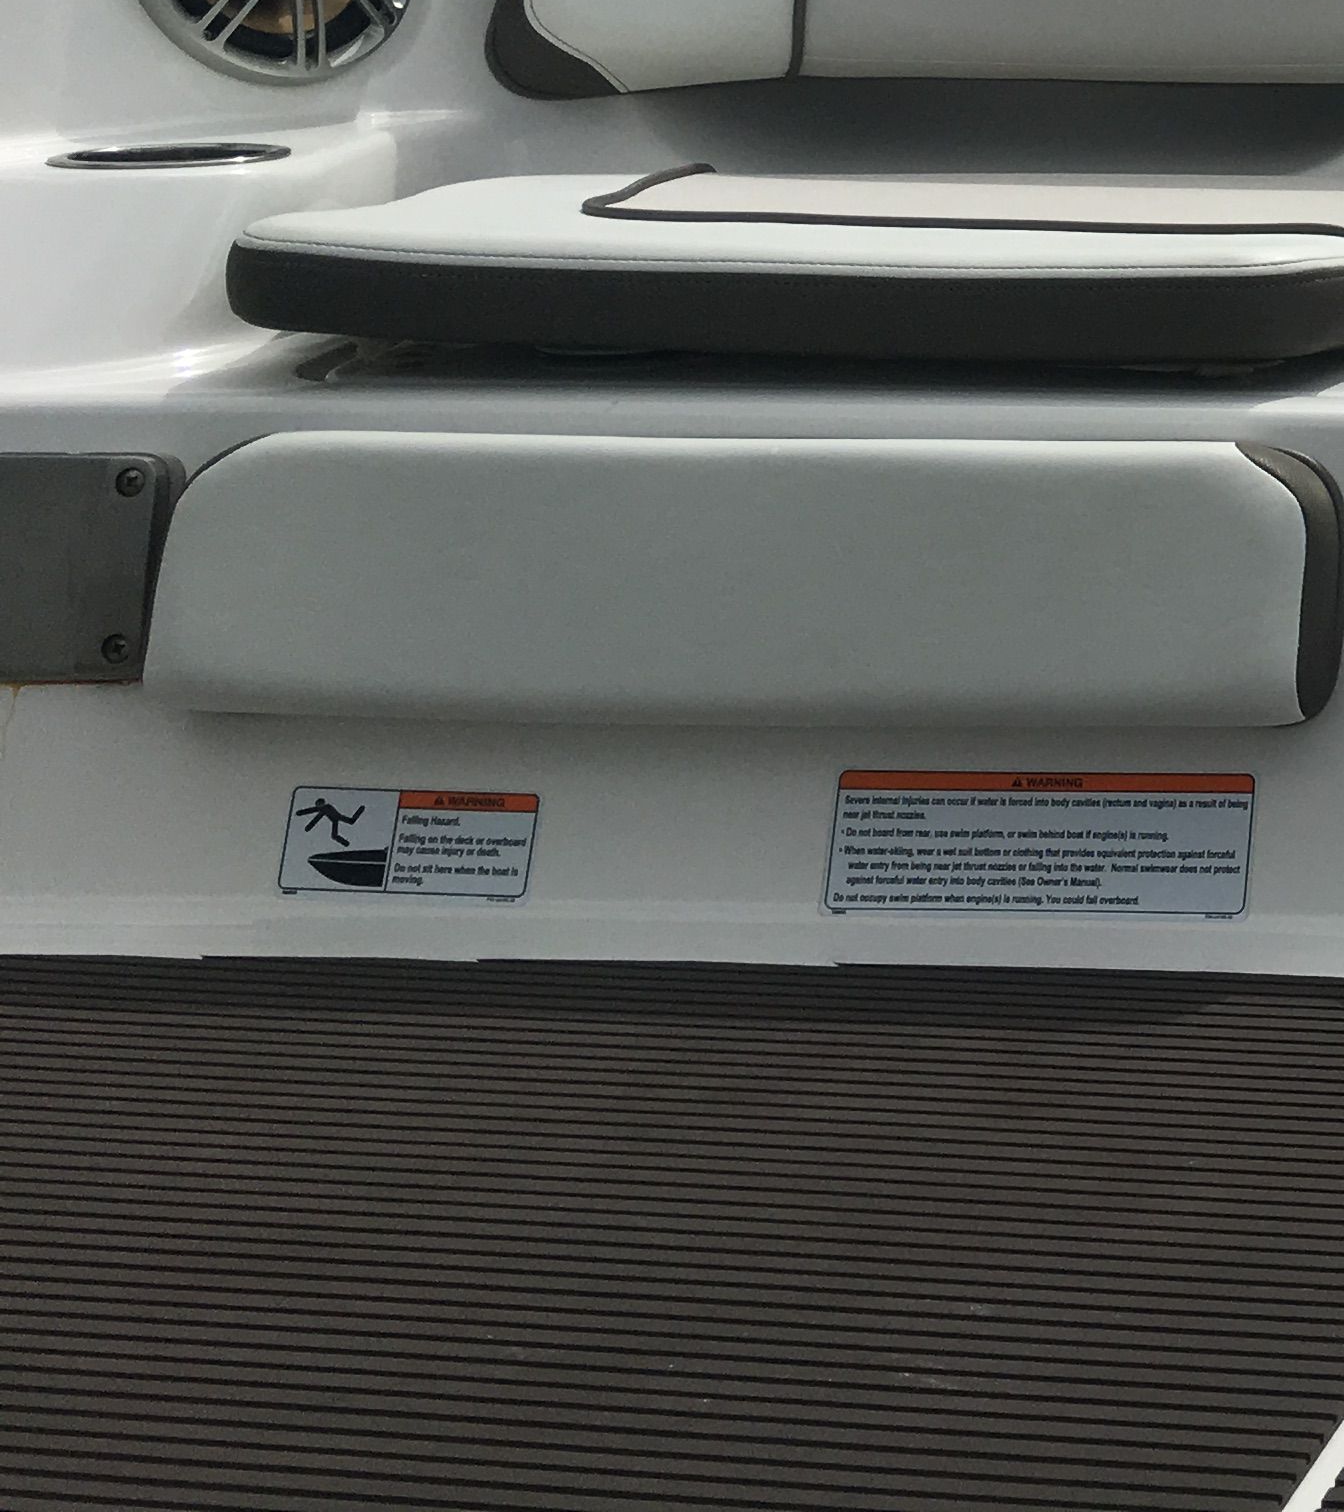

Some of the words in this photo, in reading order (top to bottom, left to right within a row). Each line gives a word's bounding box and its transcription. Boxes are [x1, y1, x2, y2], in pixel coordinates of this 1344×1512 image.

[1026, 778, 1083, 788] WARNING
[448, 797, 505, 807] WARNING
[402, 815, 429, 827] Falling
[430, 816, 460, 826] Hazard.
